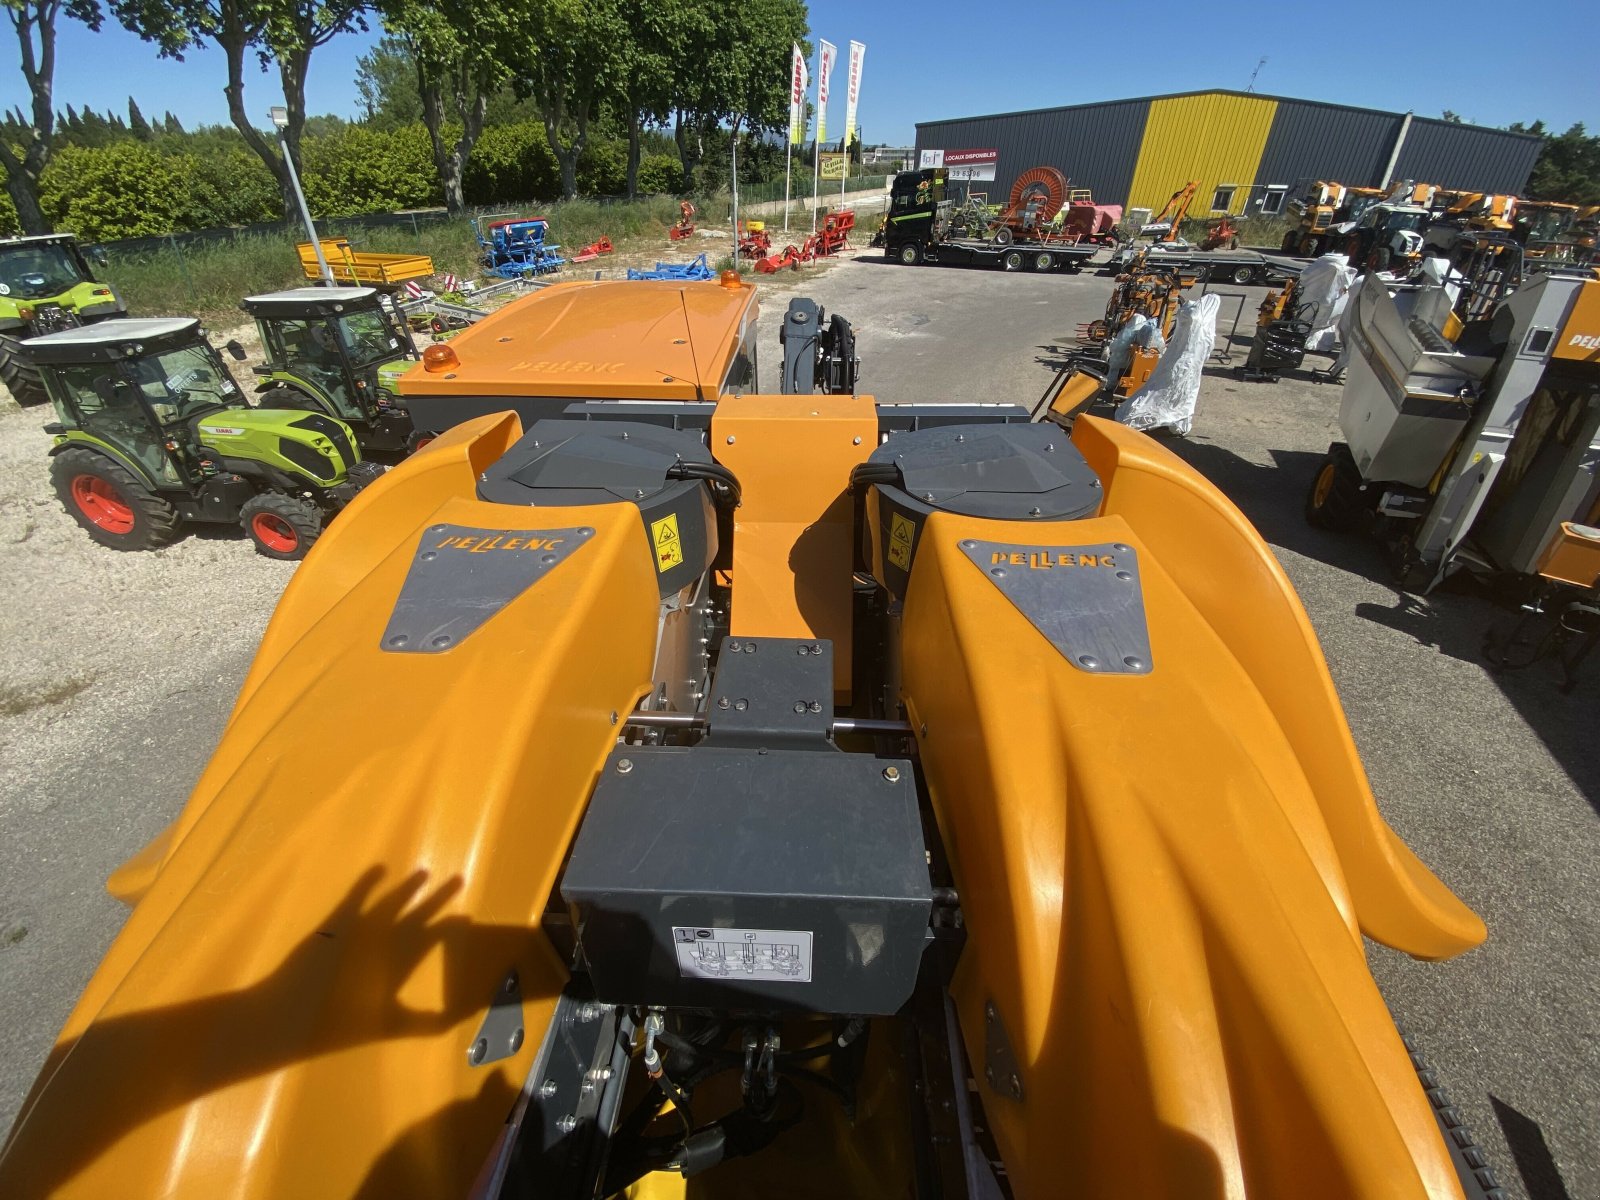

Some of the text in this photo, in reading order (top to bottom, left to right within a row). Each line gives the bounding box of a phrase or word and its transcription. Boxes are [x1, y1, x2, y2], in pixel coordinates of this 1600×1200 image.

[794, 55, 802, 104] CLAAS
[850, 51, 859, 103] CLAAS
[945, 153, 965, 161] LOCAUX
[965, 151, 997, 160] DISPONIBLES
[1568, 334, 1600, 349] PEL
[508, 361, 625, 374] PELLENC
[436, 535, 564, 553] PELLENC
[991, 550, 1117, 570] PELLENC
